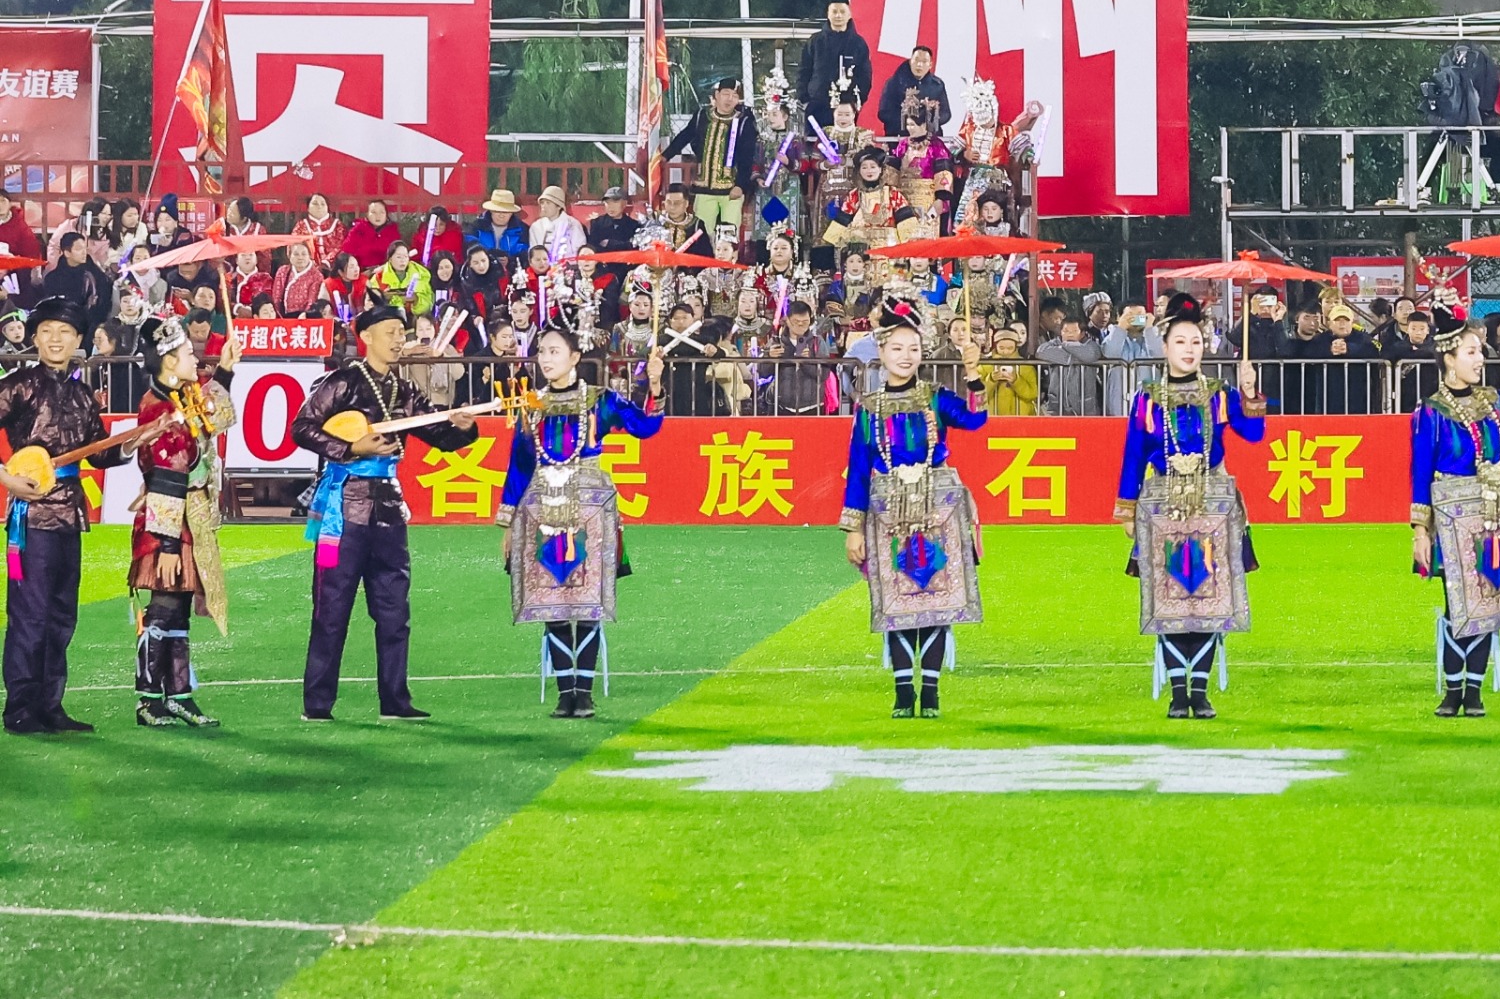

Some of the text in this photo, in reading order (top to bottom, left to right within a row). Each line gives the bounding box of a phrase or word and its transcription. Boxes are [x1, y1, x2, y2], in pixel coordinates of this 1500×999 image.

[0, 68, 79, 100] 友谊赛
[233, 325, 327, 350] 村超代表队
[242, 373, 306, 462] 0
